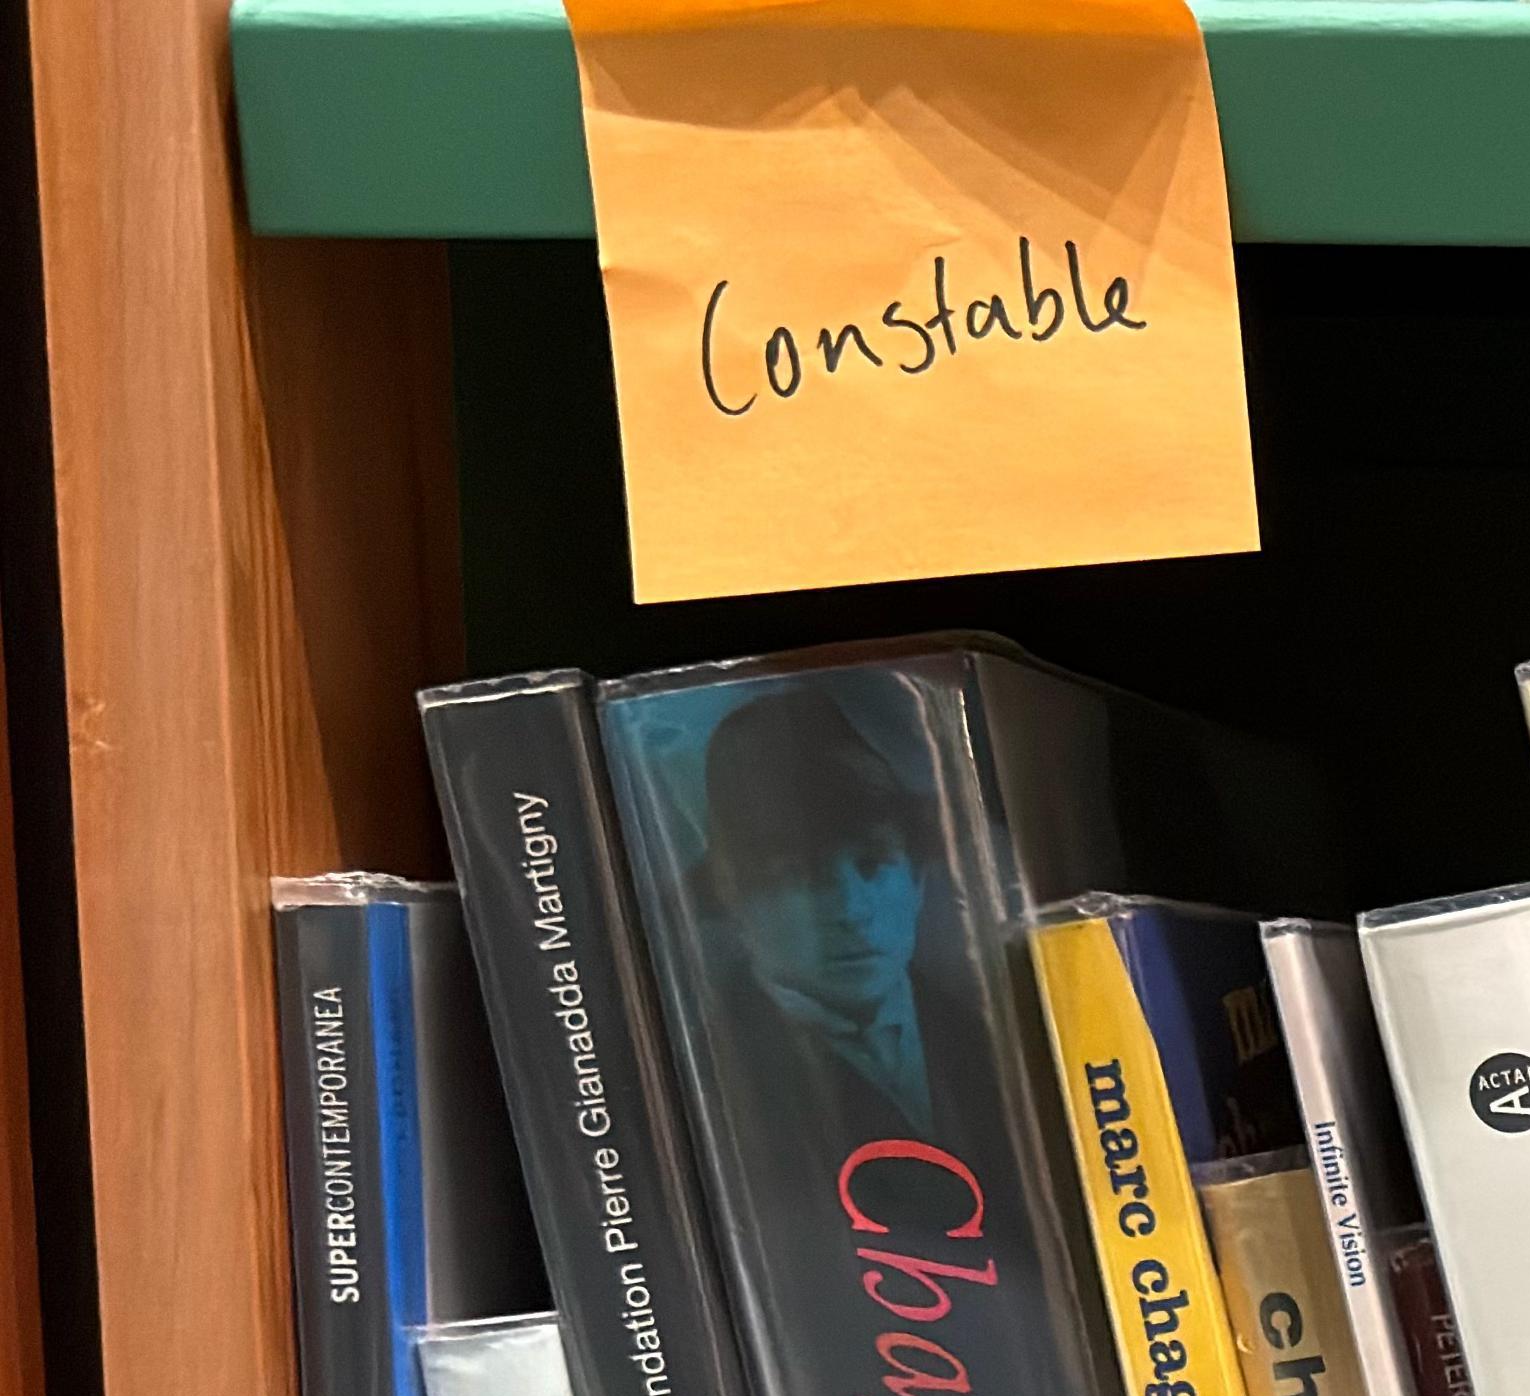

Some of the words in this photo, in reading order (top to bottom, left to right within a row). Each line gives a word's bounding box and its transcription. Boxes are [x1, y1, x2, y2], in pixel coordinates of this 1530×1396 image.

[702, 237, 1147, 416] Constable
[512, 792, 572, 953] Martigny
[558, 960, 612, 1137] Gianadda
[312, 986, 360, 1304] SUPERCONTEMPORANEA
[599, 1147, 641, 1253] Pierre
[1084, 1059, 1156, 1238] marc
[1314, 1120, 1348, 1209] Infinite
[1336, 1212, 1365, 1288] Vision
